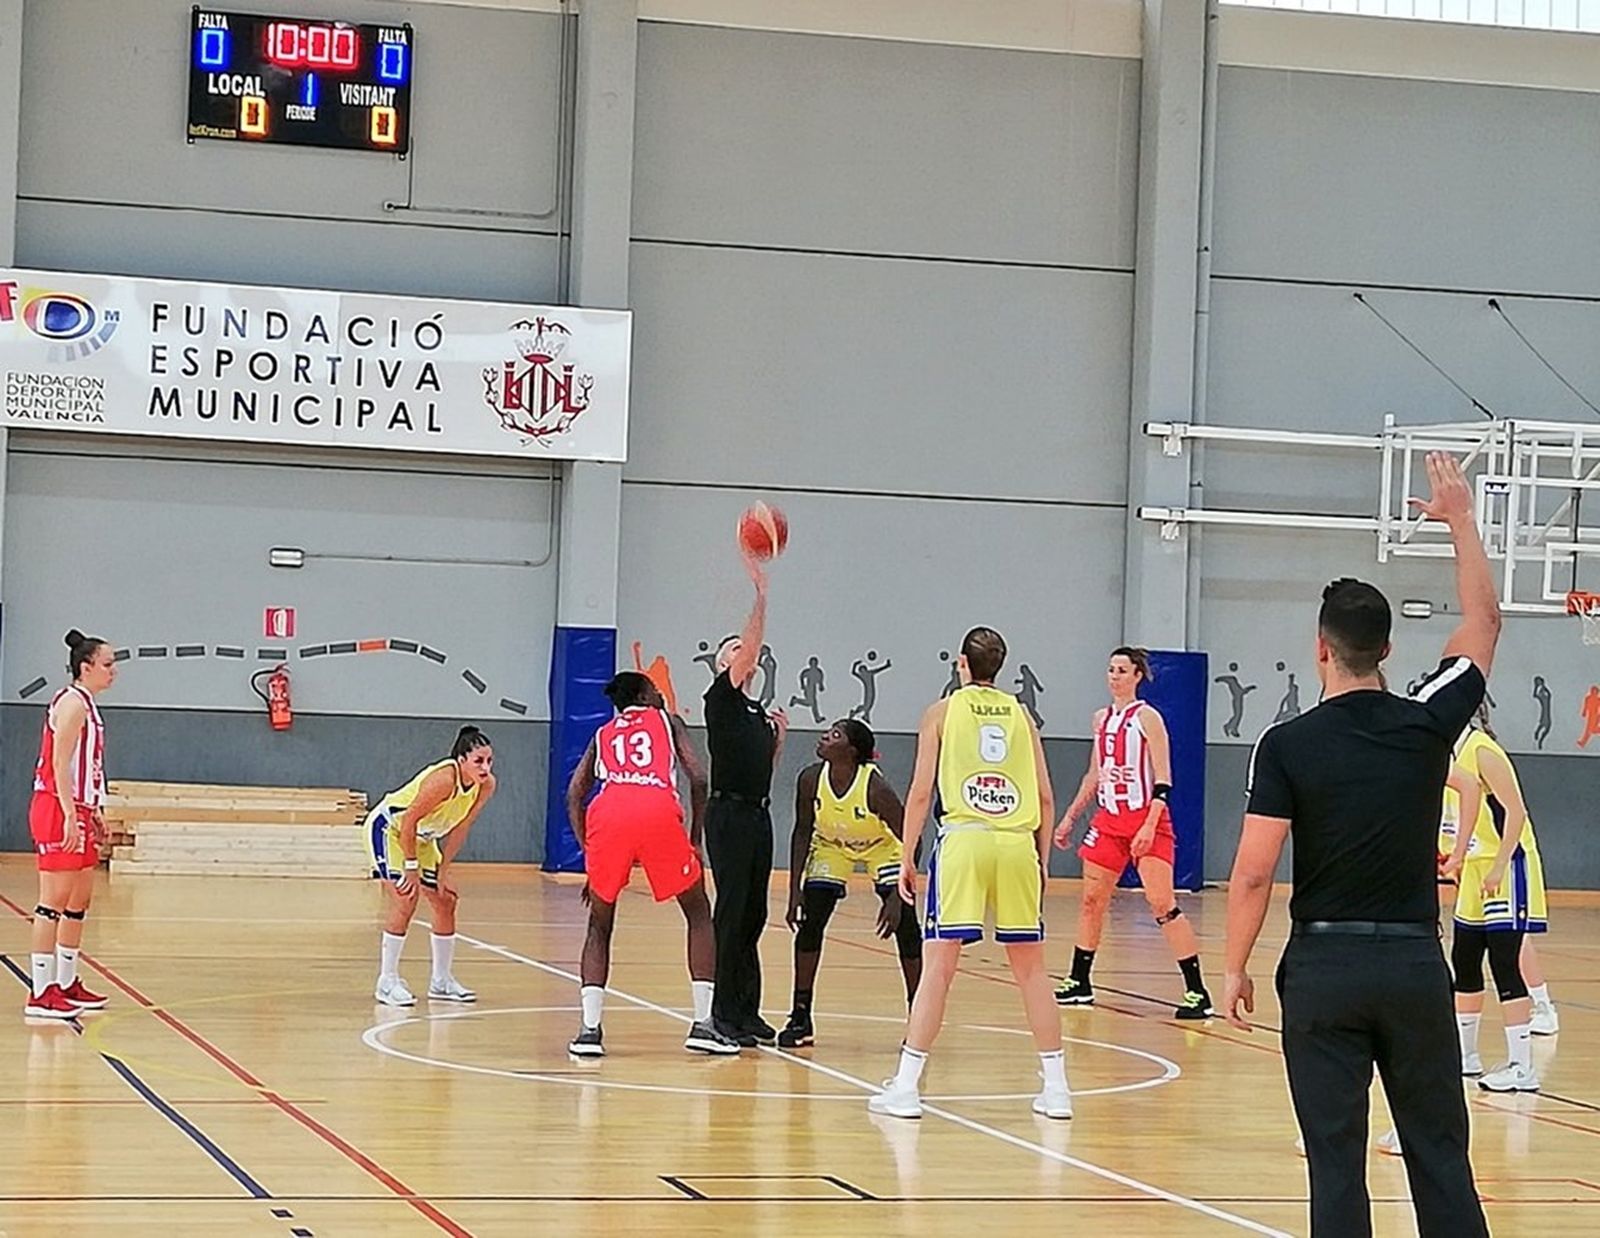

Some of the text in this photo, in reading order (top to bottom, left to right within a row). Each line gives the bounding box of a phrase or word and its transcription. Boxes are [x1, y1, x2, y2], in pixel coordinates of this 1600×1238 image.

[198, 14, 228, 30] FALTA
[267, 22, 355, 65] 10:00
[378, 28, 408, 45] FALTA
[207, 73, 266, 98] LOCAL
[339, 82, 397, 108] VISITANT
[151, 302, 444, 351] FUNDACIÓ
[150, 345, 441, 392] ESPORTIVA
[6, 384, 105, 401] DEPORTIVA
[6, 396, 104, 413] MUNICIPAL
[6, 408, 105, 423] VALENCIA
[147, 386, 443, 434] MUNICIPAL
[610, 730, 653, 768] 13
[978, 724, 1008, 764] 6
[967, 785, 1016, 805] Picken
